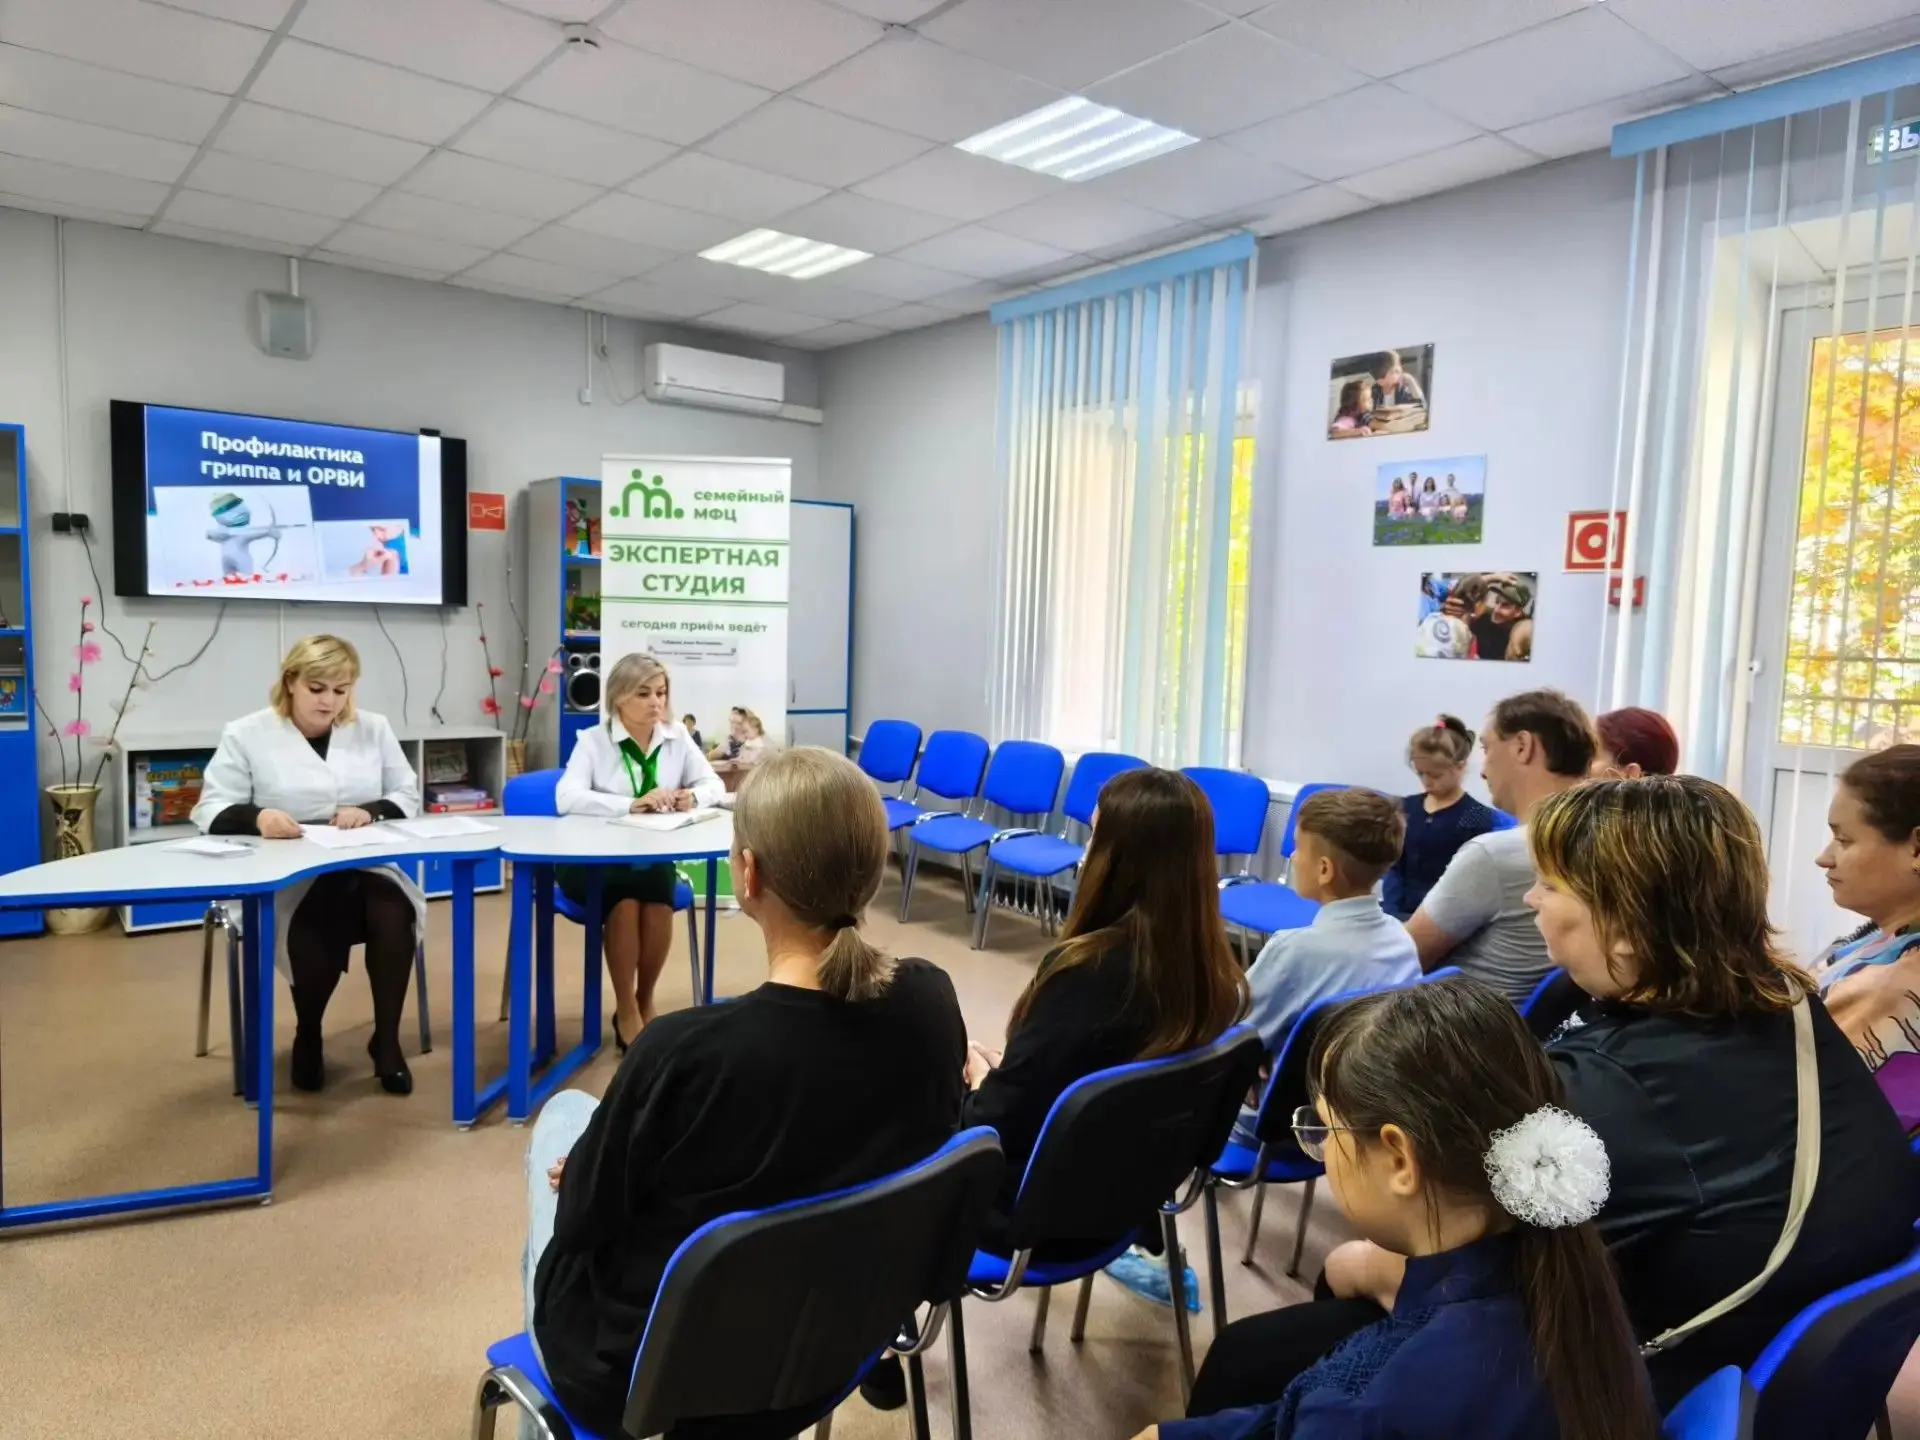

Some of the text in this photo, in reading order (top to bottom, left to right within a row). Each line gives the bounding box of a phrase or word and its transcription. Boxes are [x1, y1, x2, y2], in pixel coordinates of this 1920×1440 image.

[201, 430, 364, 464] Профилактика
[201, 459, 365, 489] гриппа и ОРВИ
[694, 488, 784, 503] семейный
[693, 507, 737, 523] МФЦ
[609, 544, 779, 567] ЭКСПЕРТНАЯ
[643, 574, 745, 596] СТУДИЯ
[621, 619, 768, 633] сегодня приём ведёт
